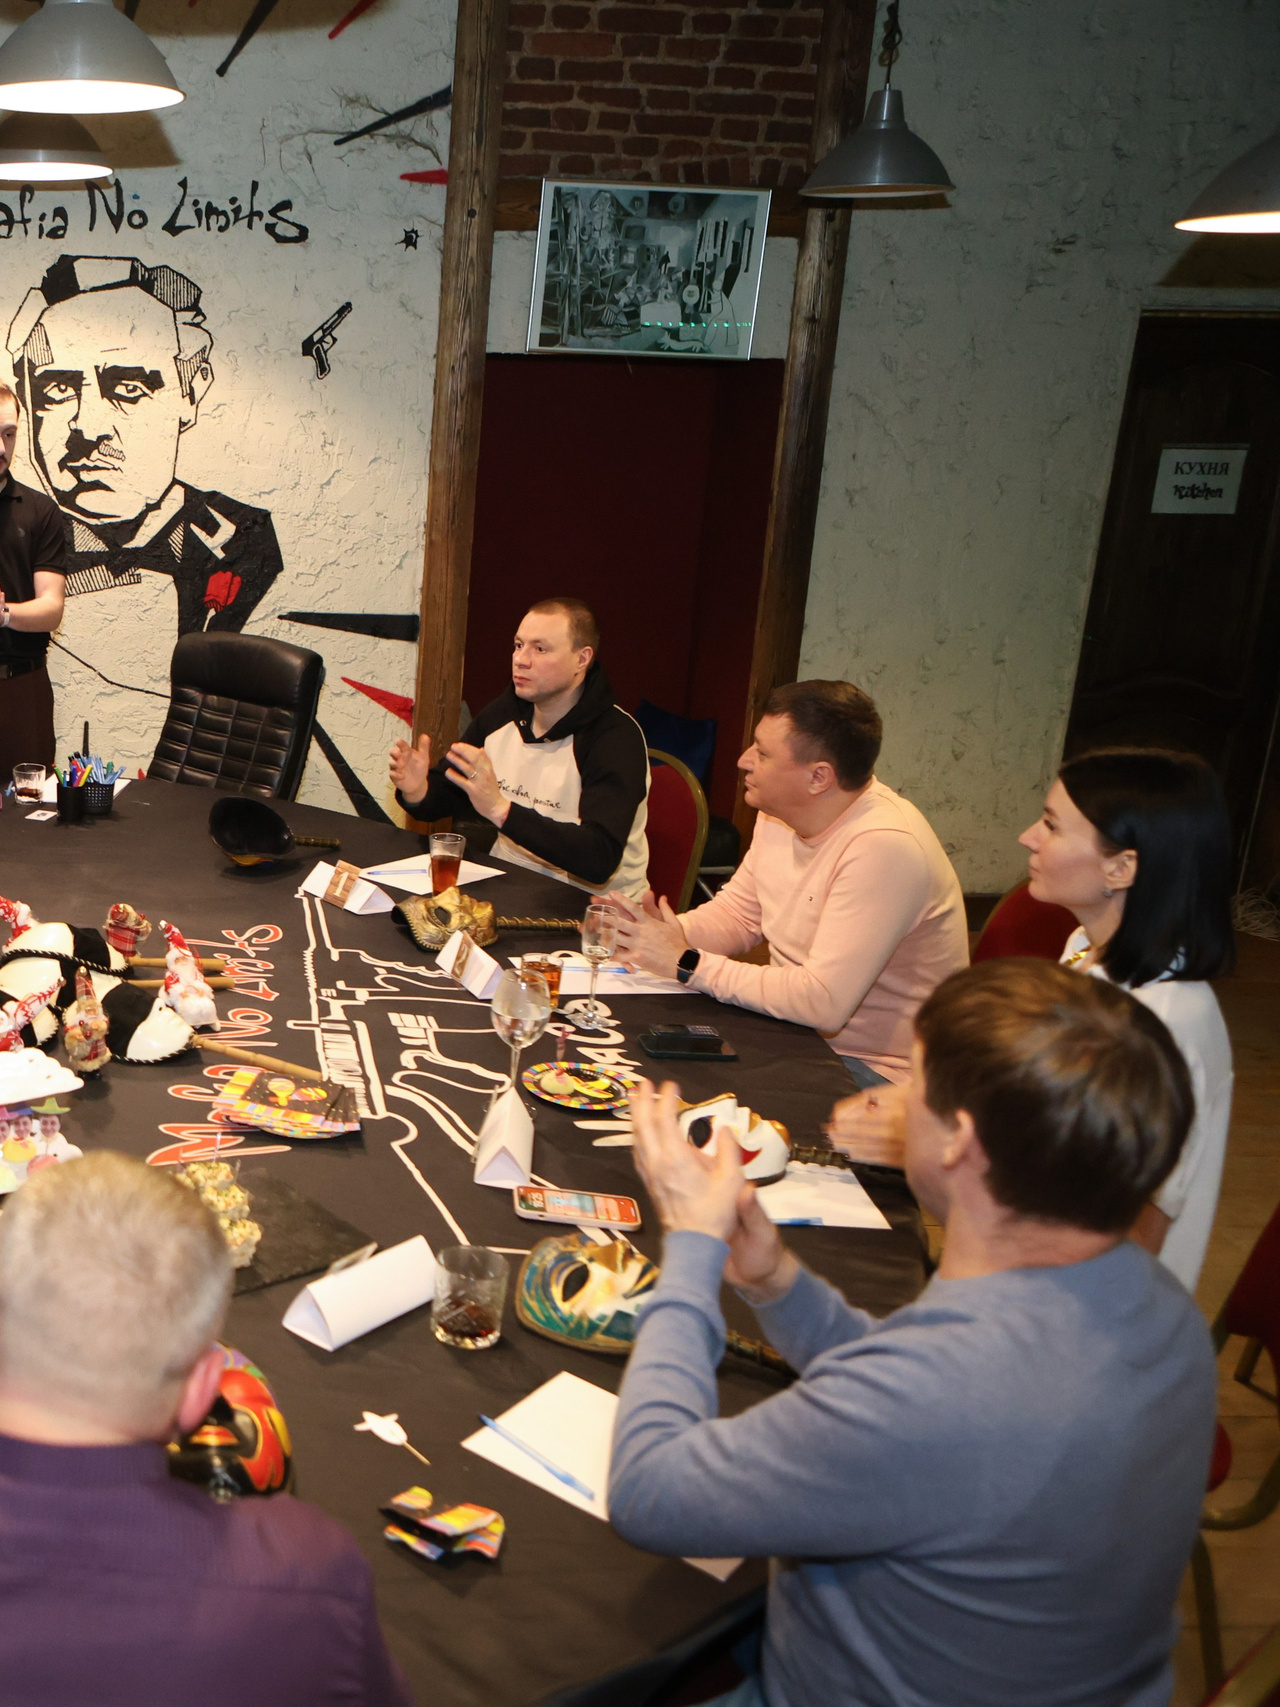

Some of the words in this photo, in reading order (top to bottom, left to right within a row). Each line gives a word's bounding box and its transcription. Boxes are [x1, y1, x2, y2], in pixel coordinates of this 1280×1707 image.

[84, 178, 149, 234] No
[162, 176, 310, 244] Limits
[1174, 461, 1230, 475] КУХНЯ
